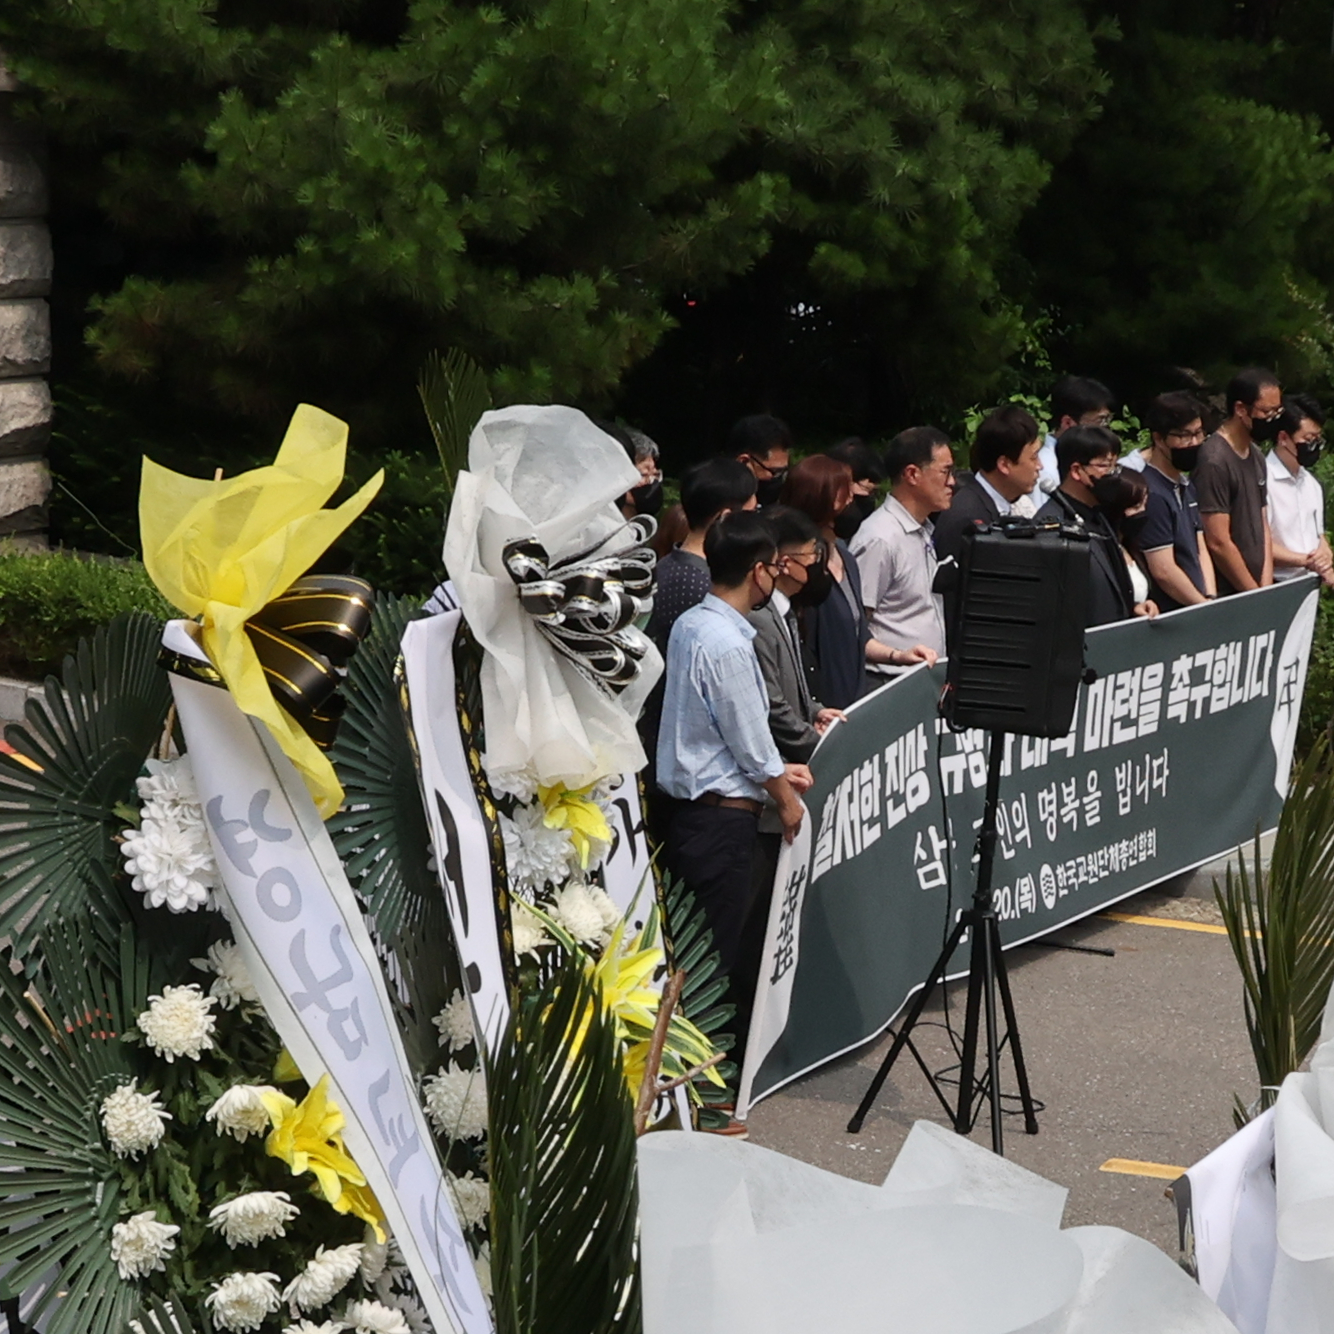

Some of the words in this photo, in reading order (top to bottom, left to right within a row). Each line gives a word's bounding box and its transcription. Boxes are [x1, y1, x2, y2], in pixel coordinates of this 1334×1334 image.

[884, 722, 930, 830] 진상
[1083, 662, 1164, 752] 마련을
[1167, 630, 1276, 724] 촉구합니다
[1038, 769, 1102, 842] 명복을
[1114, 747, 1170, 816] 빕니다
[1055, 827, 1157, 898] 한국교원단체총연합회
